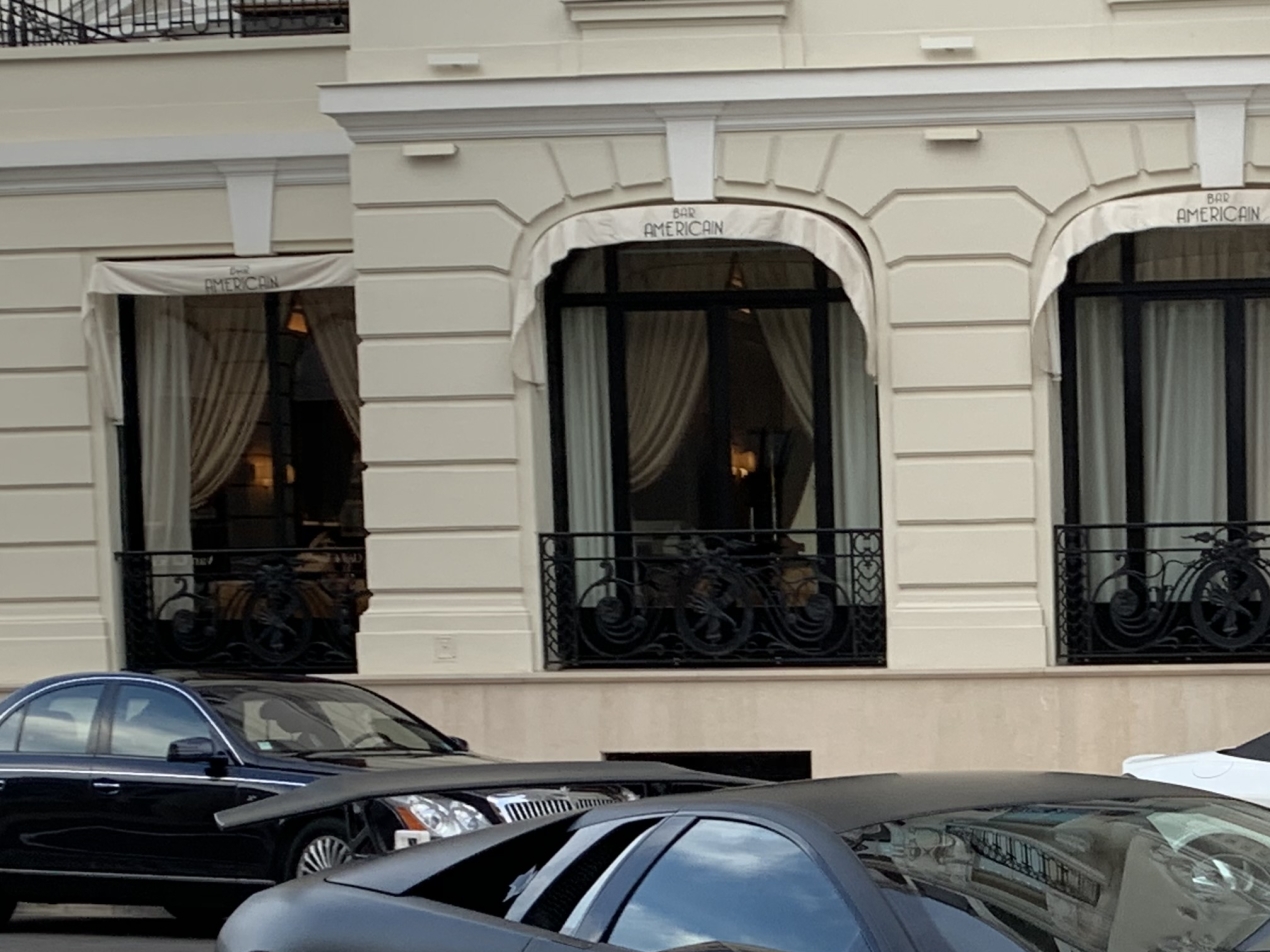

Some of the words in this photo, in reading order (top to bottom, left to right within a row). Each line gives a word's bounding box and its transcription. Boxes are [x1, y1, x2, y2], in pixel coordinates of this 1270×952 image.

[1207, 192, 1230, 205] BAR
[672, 207, 696, 219] BAR
[1176, 205, 1260, 223] AMERICAIN
[644, 219, 724, 238] AMERICAIN
